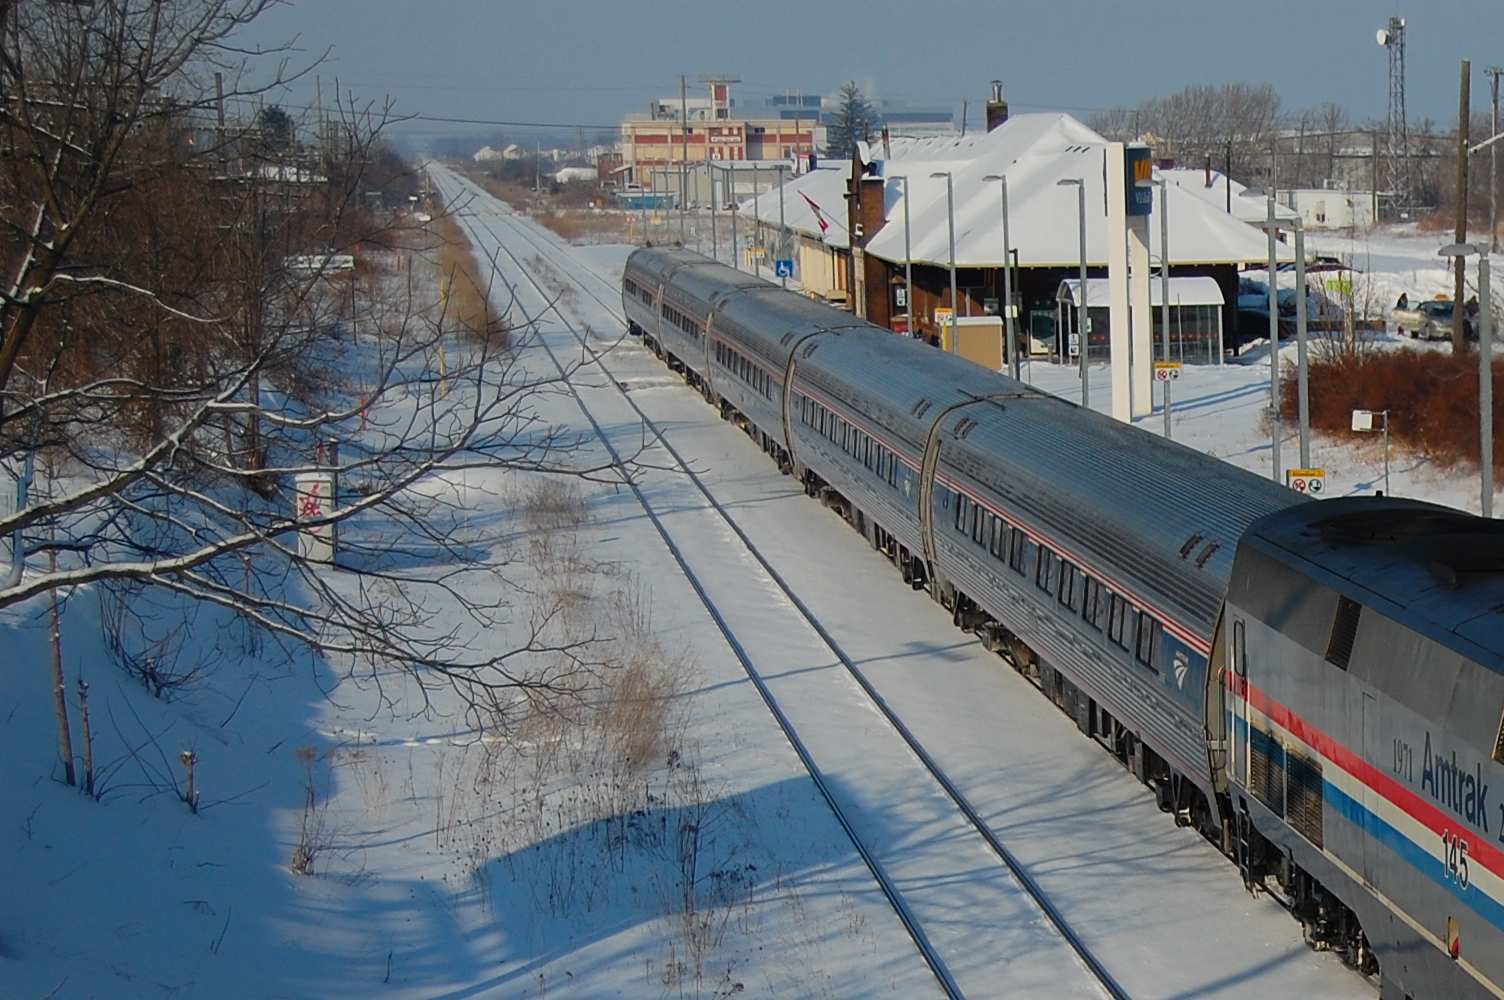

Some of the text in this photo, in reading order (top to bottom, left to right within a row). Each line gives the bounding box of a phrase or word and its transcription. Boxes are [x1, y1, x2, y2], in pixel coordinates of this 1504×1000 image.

[1393, 738, 1413, 783] 1971
[1421, 731, 1489, 833] Amtrak
[1442, 828, 1469, 890] 145
